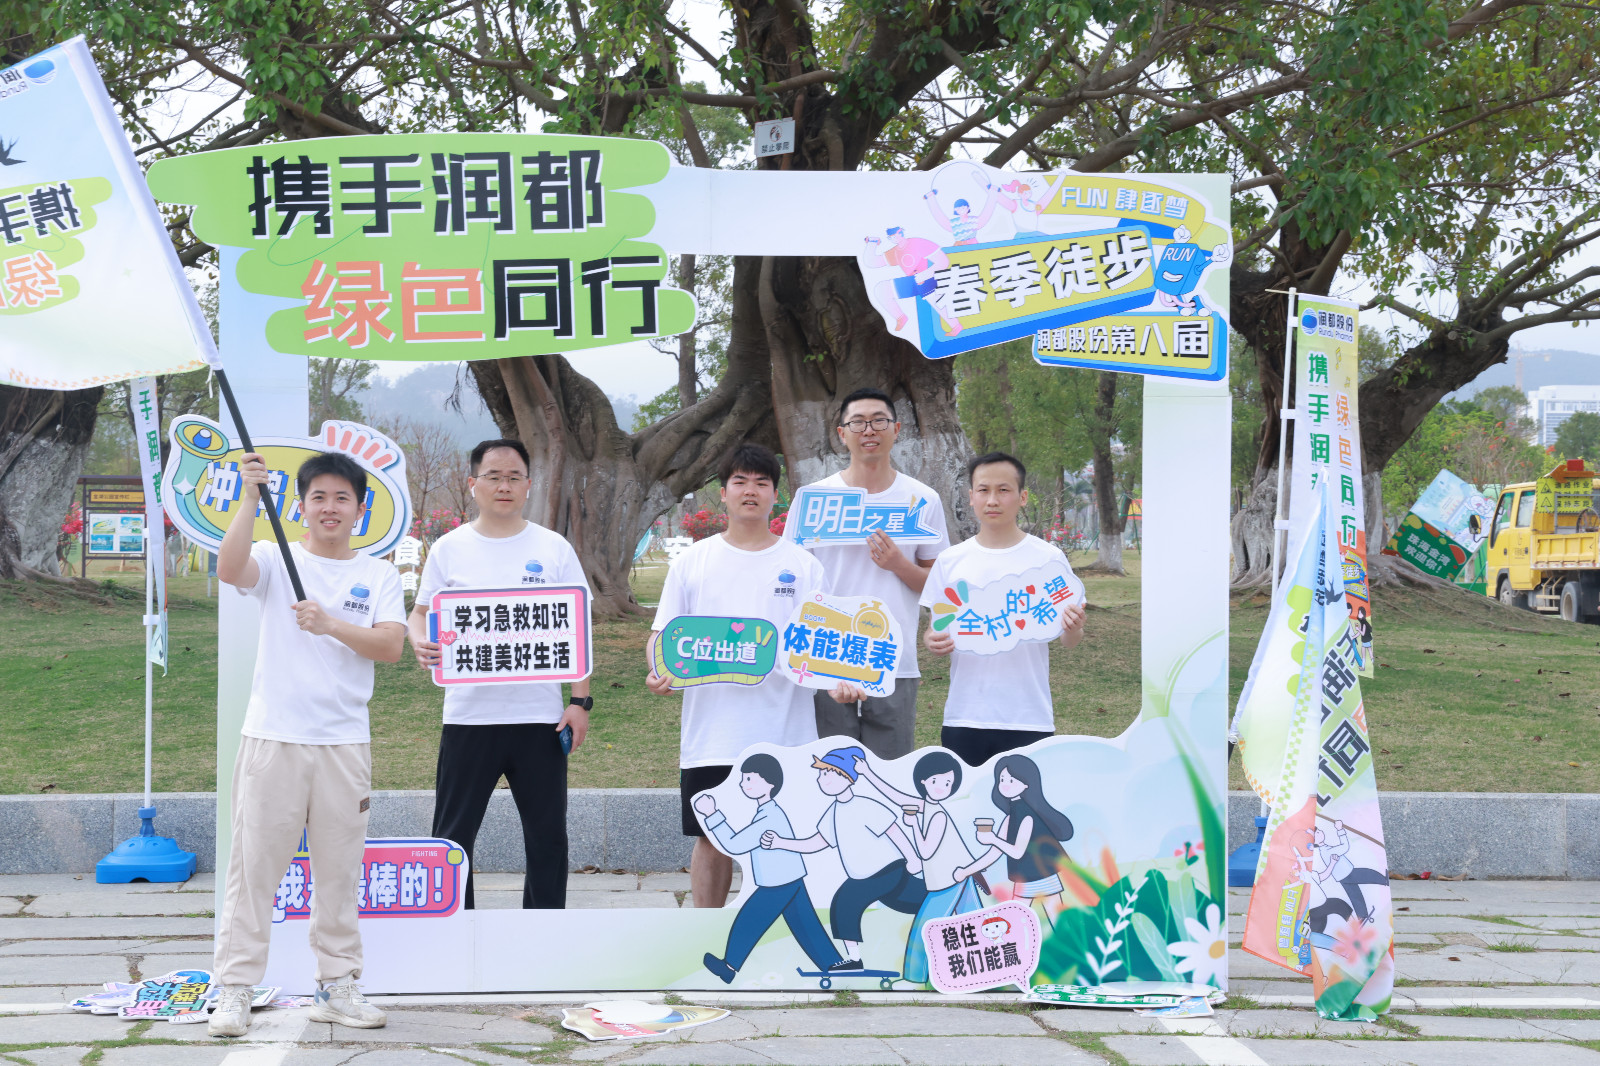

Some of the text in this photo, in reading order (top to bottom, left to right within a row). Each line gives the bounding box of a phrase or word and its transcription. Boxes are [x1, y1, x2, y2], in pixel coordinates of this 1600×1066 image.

[246, 149, 604, 238] 携手润都
[1061, 186, 1108, 210] FUN
[1163, 246, 1197, 262] RUN
[933, 233, 1153, 321] 春季徒步
[300, 255, 664, 348] 绿色同行
[1037, 320, 1210, 359] 润都股份第八届
[1318, 311, 1353, 333] 润都股份
[1308, 352, 1330, 491] 携手润
[1336, 393, 1358, 547] 绿色同行
[804, 495, 905, 534] 明日之星
[1407, 533, 1451, 567] 珠海金湾
[455, 603, 569, 633] 学习急救知识
[804, 613, 826, 623] BOOM!
[956, 575, 1074, 642] 全村的希望
[456, 641, 571, 672] 共建美好生活
[676, 636, 757, 664] C位出道
[784, 622, 898, 672] 体能爆表
[276, 861, 444, 910] 我棒的！
[941, 923, 979, 952] 稳住
[948, 942, 1022, 979] 我们能赢
